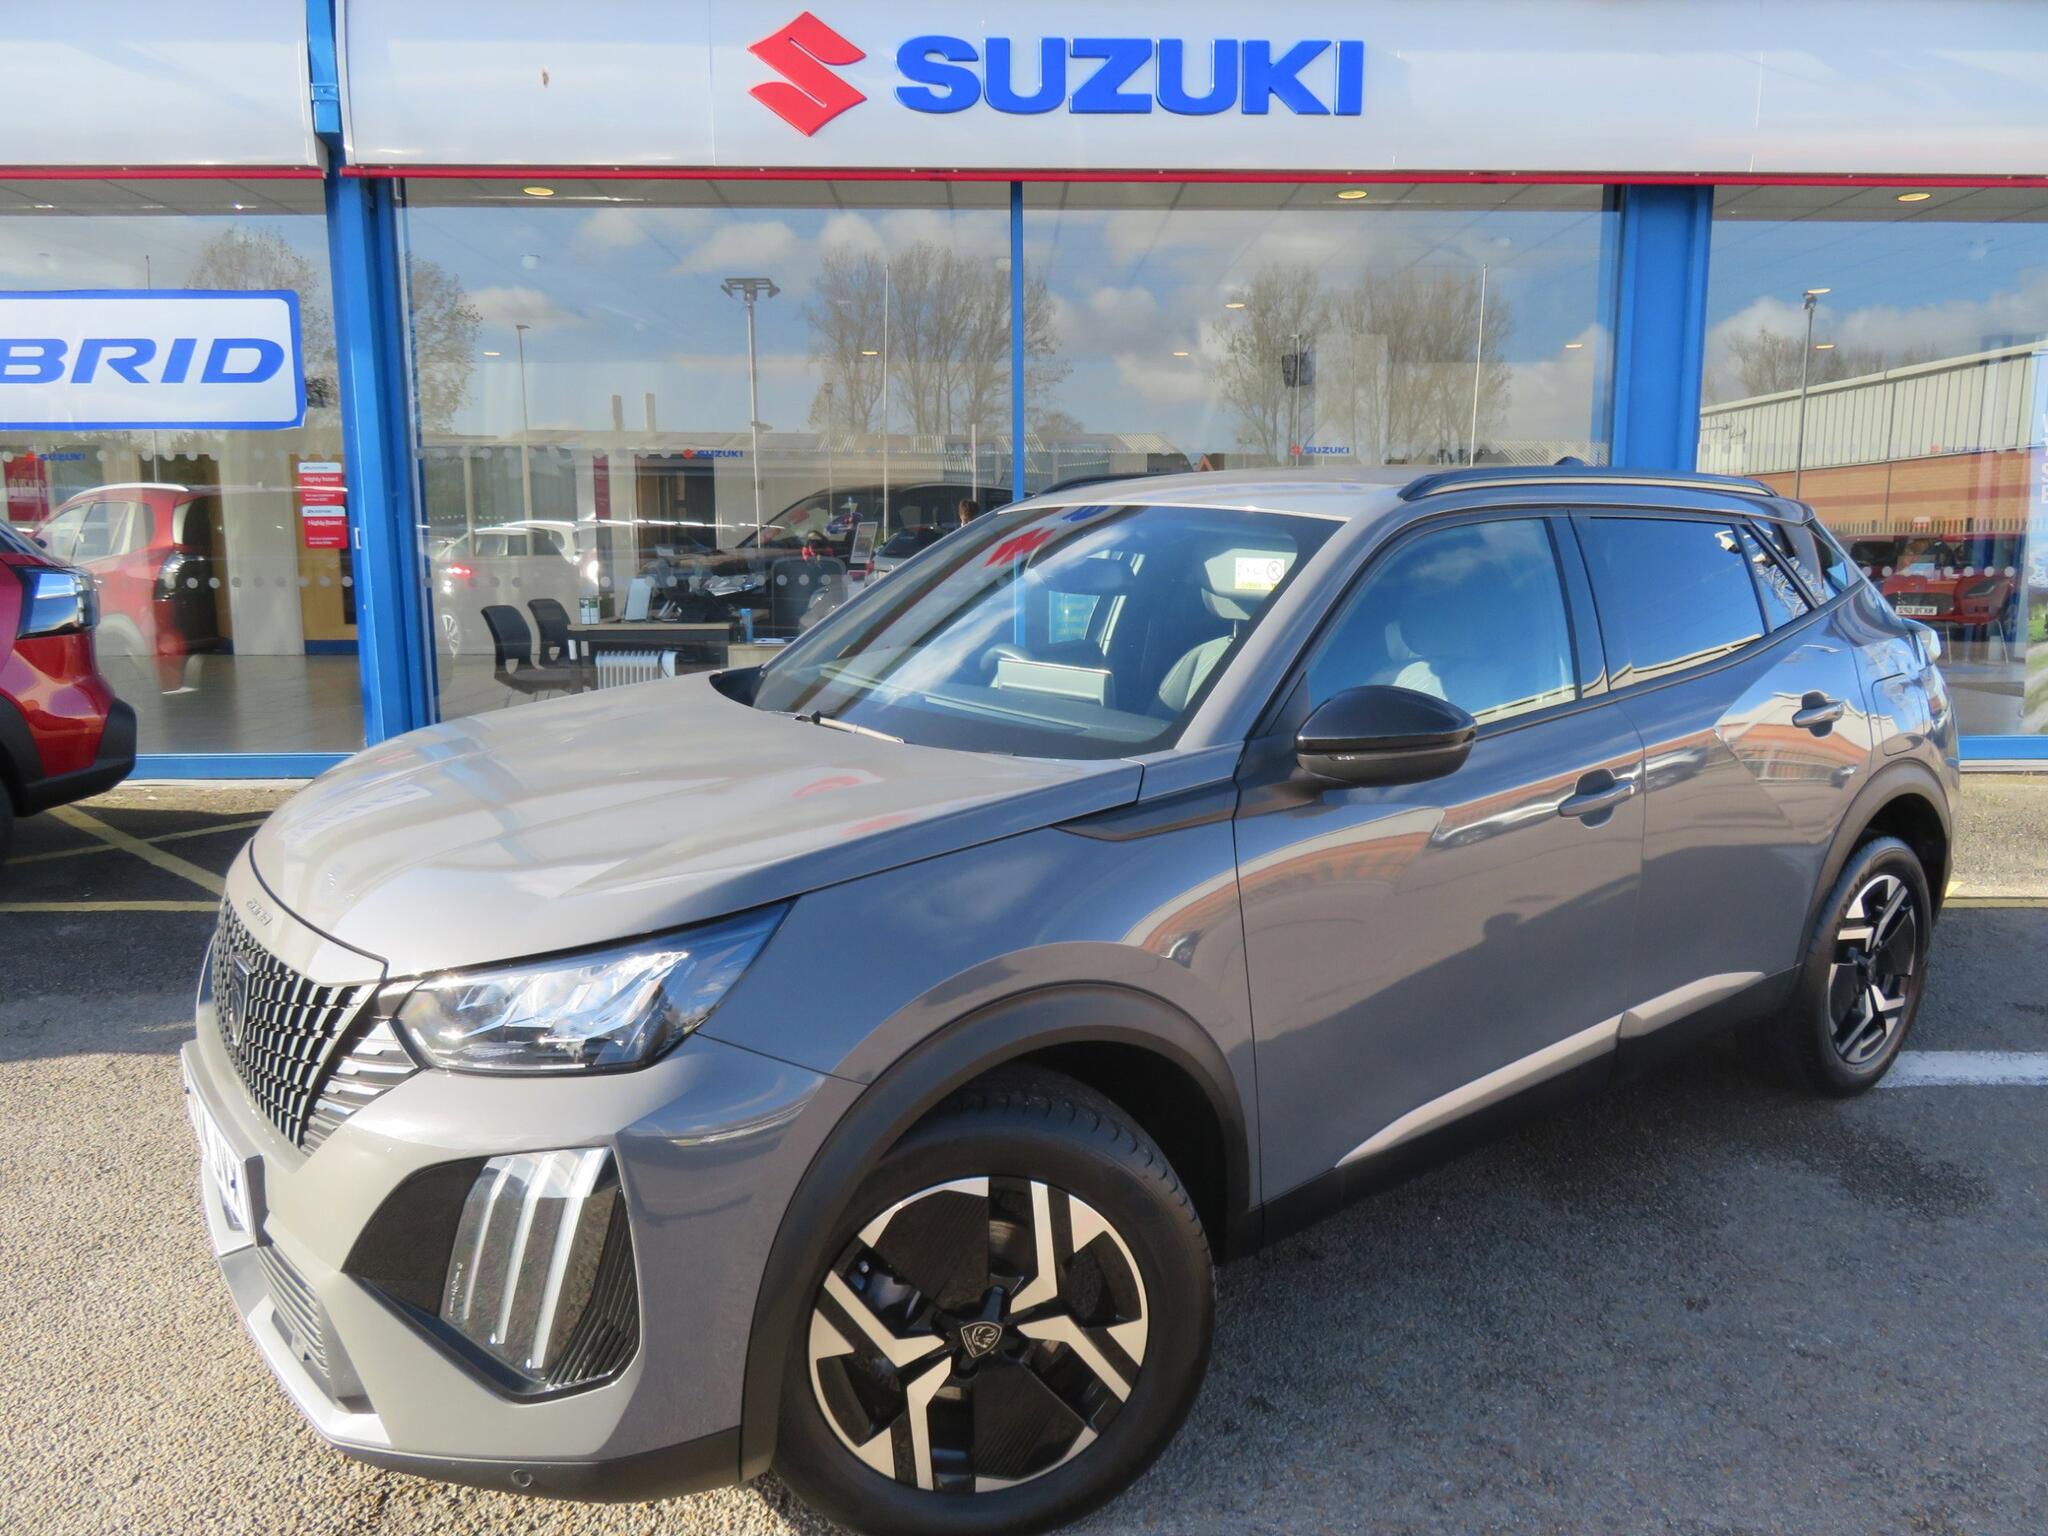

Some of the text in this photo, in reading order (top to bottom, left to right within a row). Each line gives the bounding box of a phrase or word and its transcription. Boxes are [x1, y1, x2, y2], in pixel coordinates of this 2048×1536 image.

[894, 35, 1364, 116] SUZUKI
[0, 338, 285, 384] BRID
[697, 449, 744, 458] SUZUKI
[1304, 446, 1350, 454] SUZUKI
